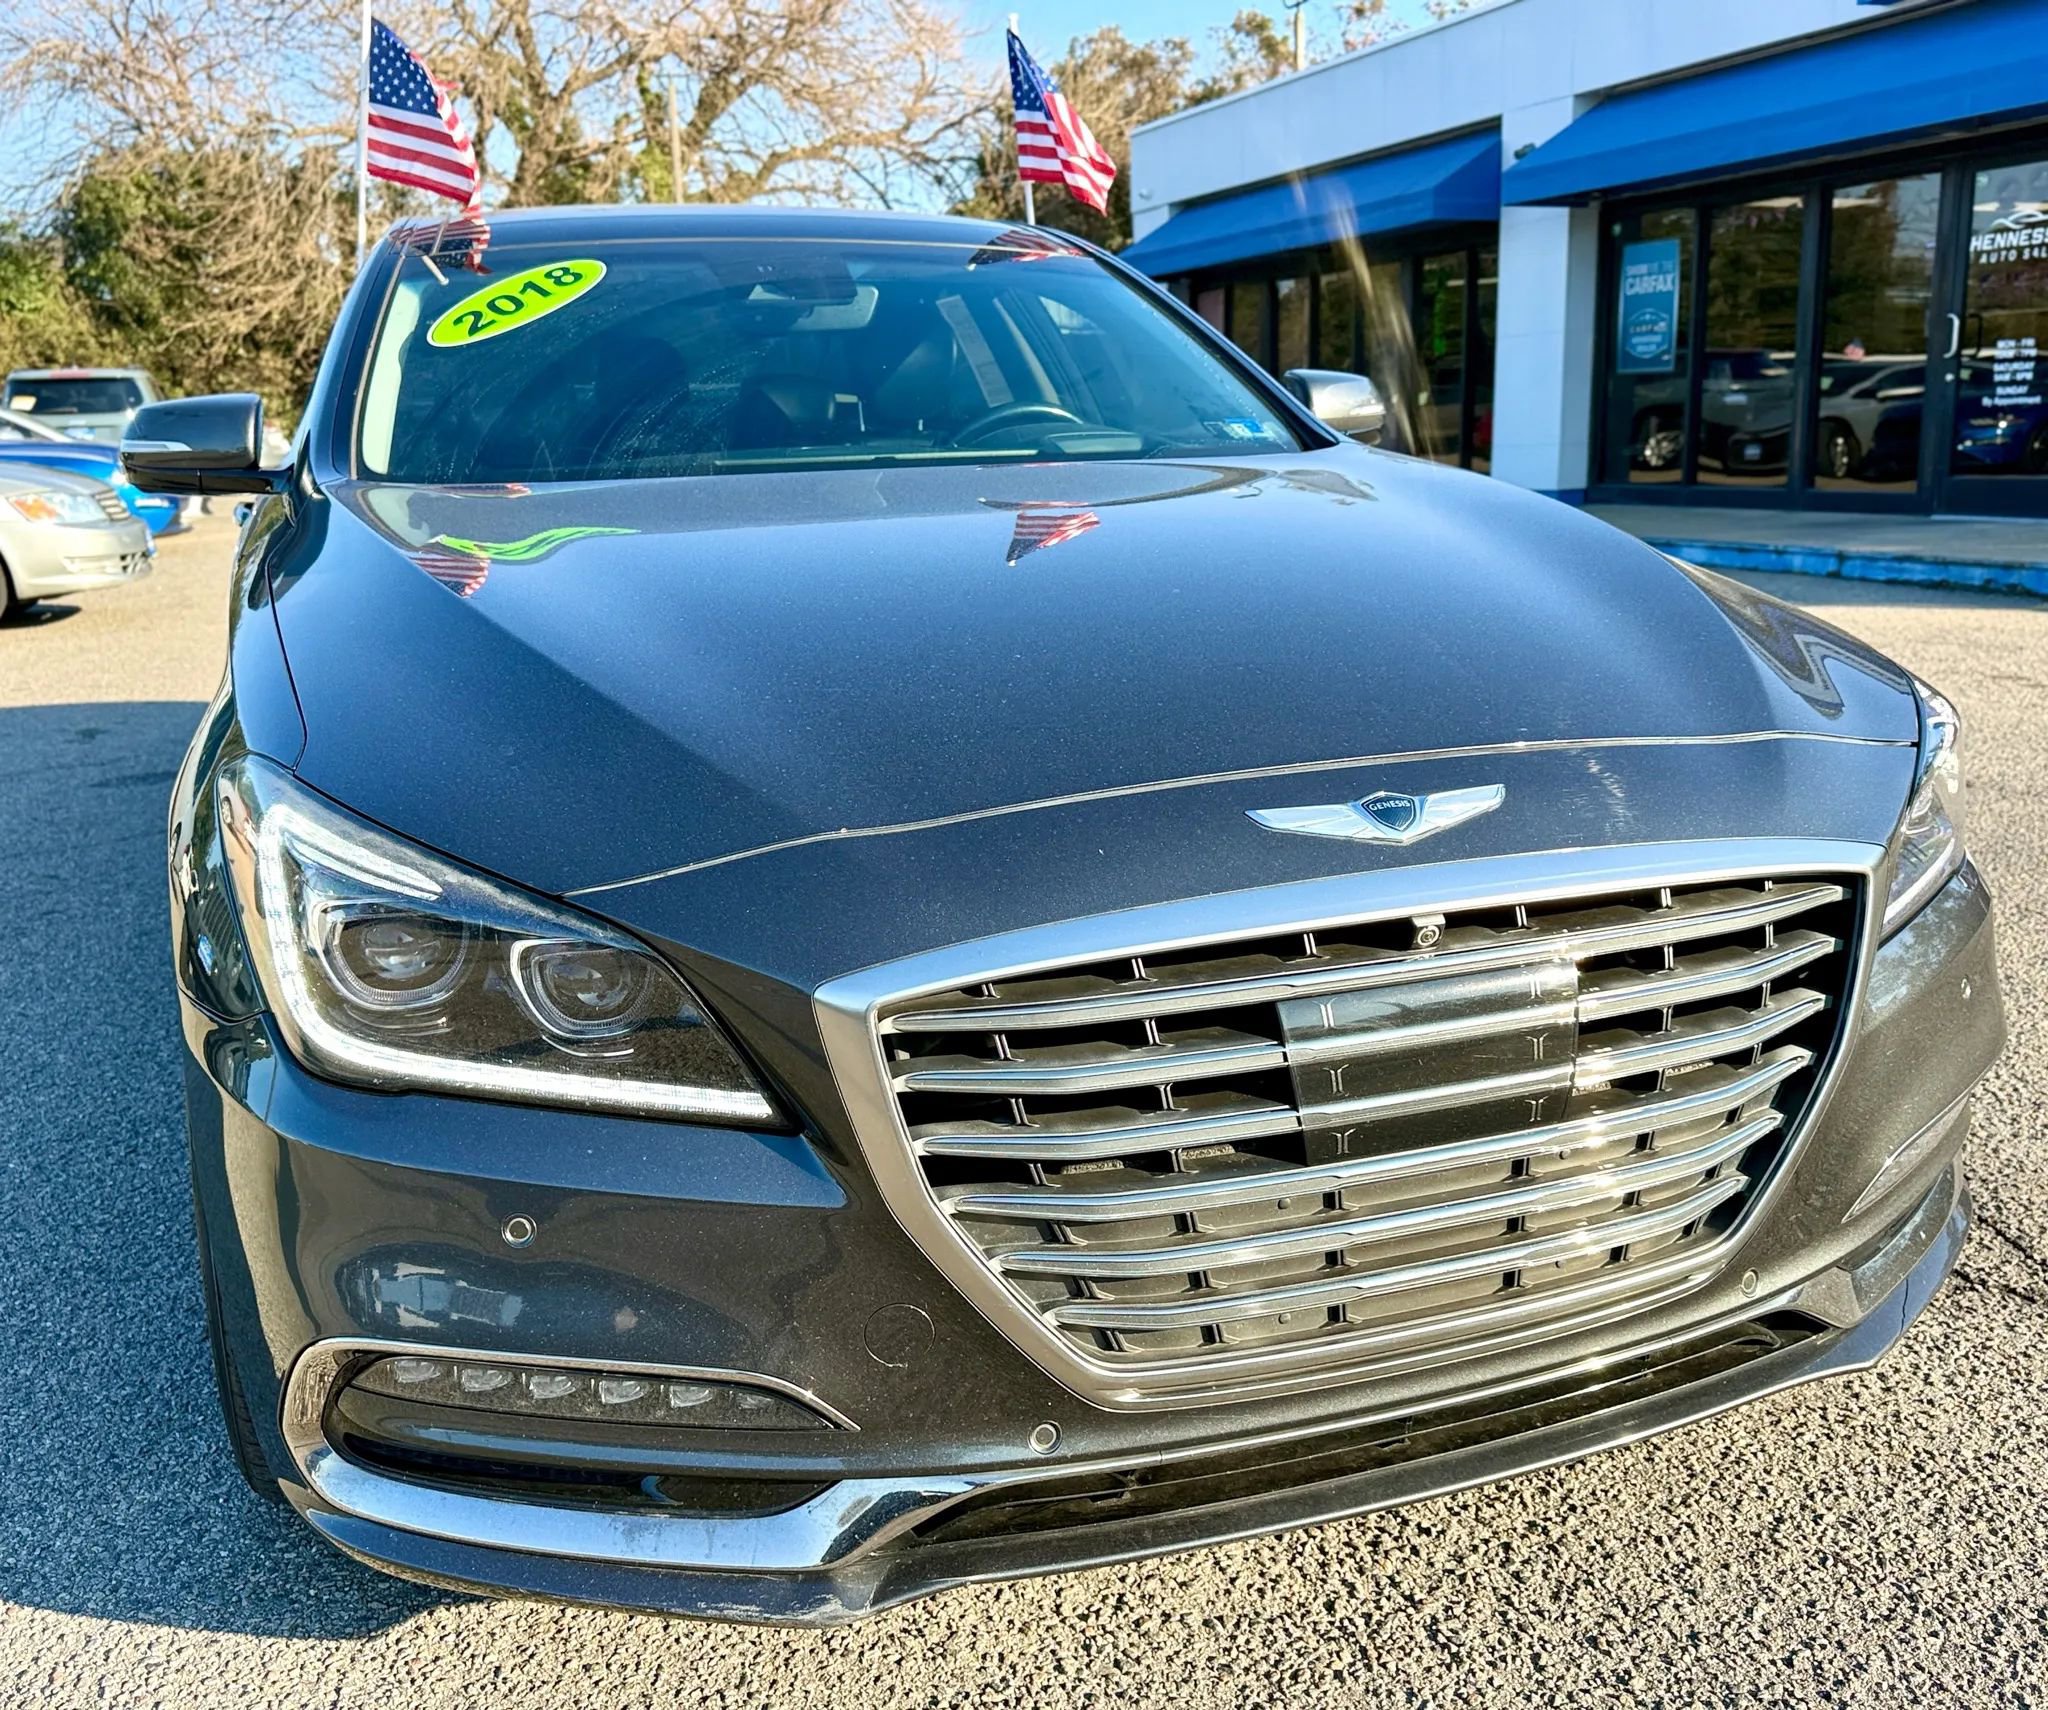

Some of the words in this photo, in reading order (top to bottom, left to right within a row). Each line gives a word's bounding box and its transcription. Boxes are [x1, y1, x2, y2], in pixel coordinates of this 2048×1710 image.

[1979, 249, 2017, 264] AUTO
[1625, 273, 1674, 296] CARFAX
[452, 266, 584, 338] 2018
[1368, 799, 1411, 811] GENESIS
